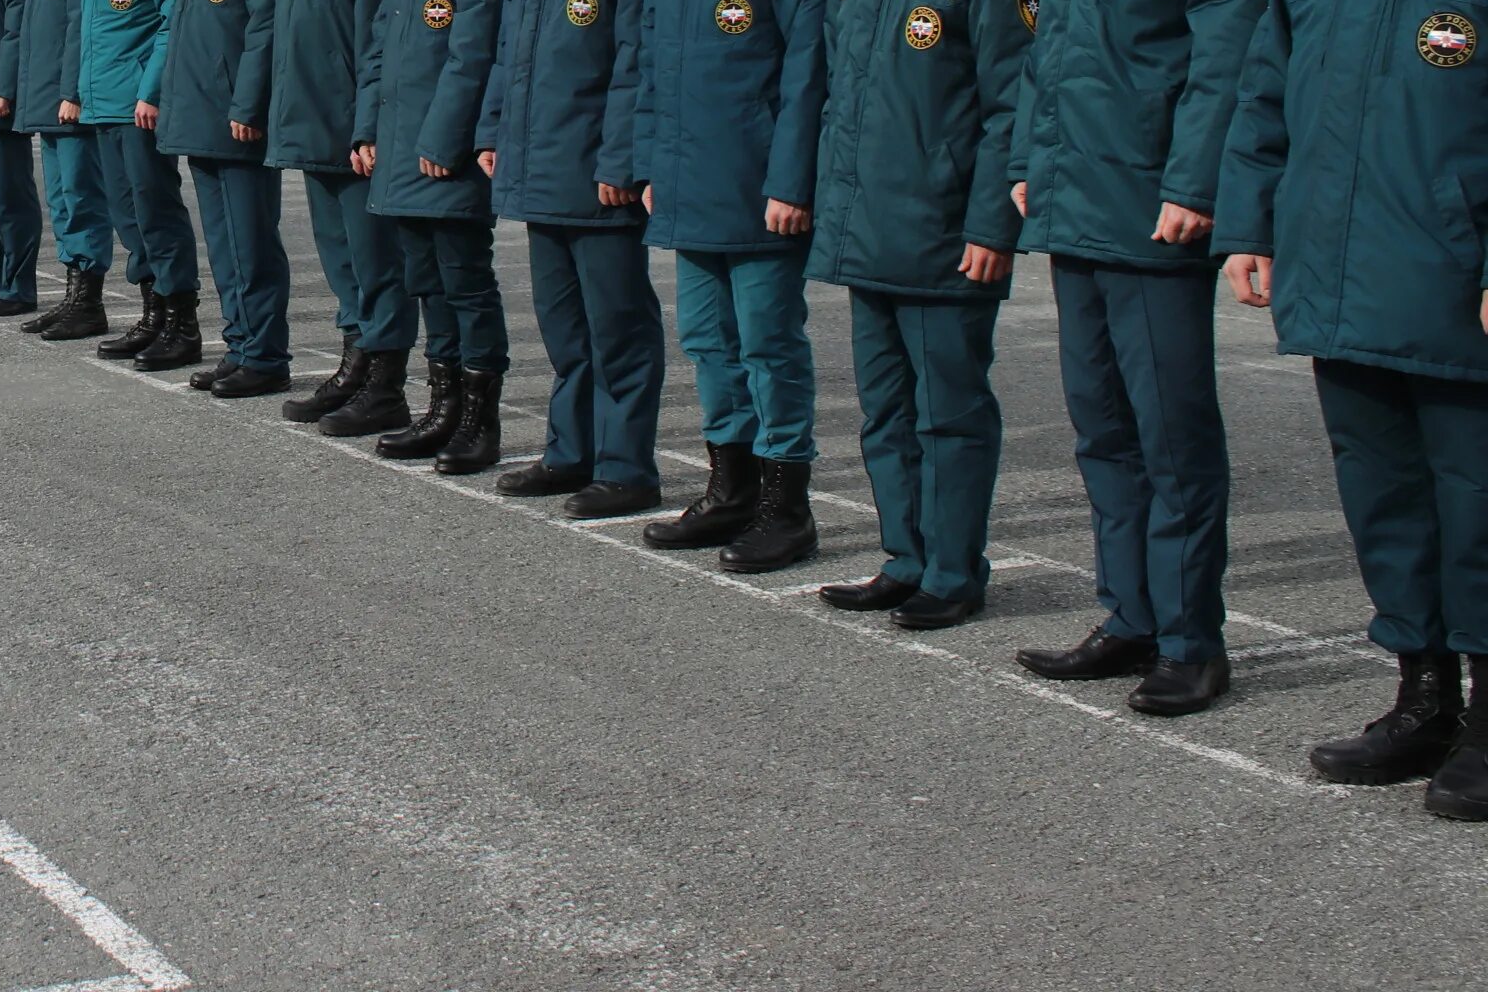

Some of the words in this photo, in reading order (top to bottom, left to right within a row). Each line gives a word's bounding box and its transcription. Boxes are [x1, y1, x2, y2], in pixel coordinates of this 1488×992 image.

[1422, 16, 1440, 34] МЧС
[1446, 15, 1476, 43] РОССИИ
[1419, 37, 1471, 65] EMERCOM
